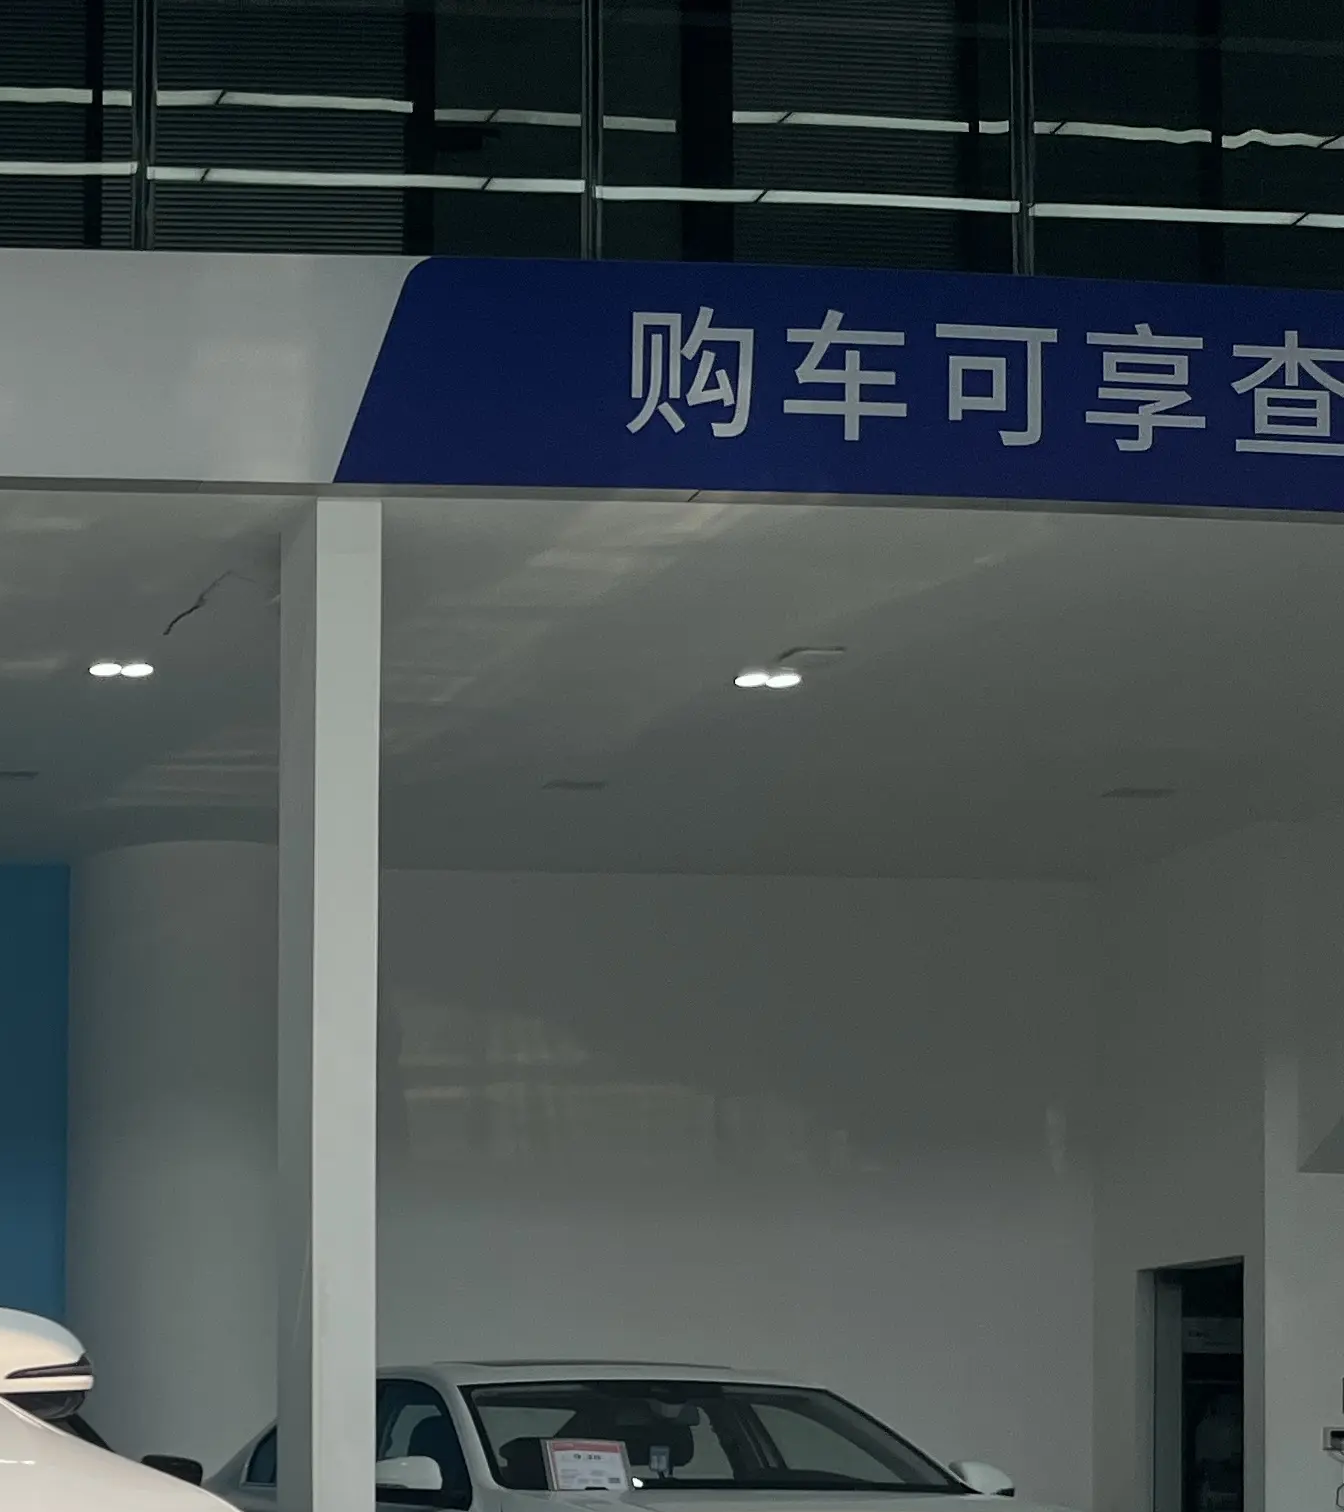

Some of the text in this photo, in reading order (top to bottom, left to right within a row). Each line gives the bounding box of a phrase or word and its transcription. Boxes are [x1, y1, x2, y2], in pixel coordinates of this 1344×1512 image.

[625, 306, 1344, 456] 购车可享查
